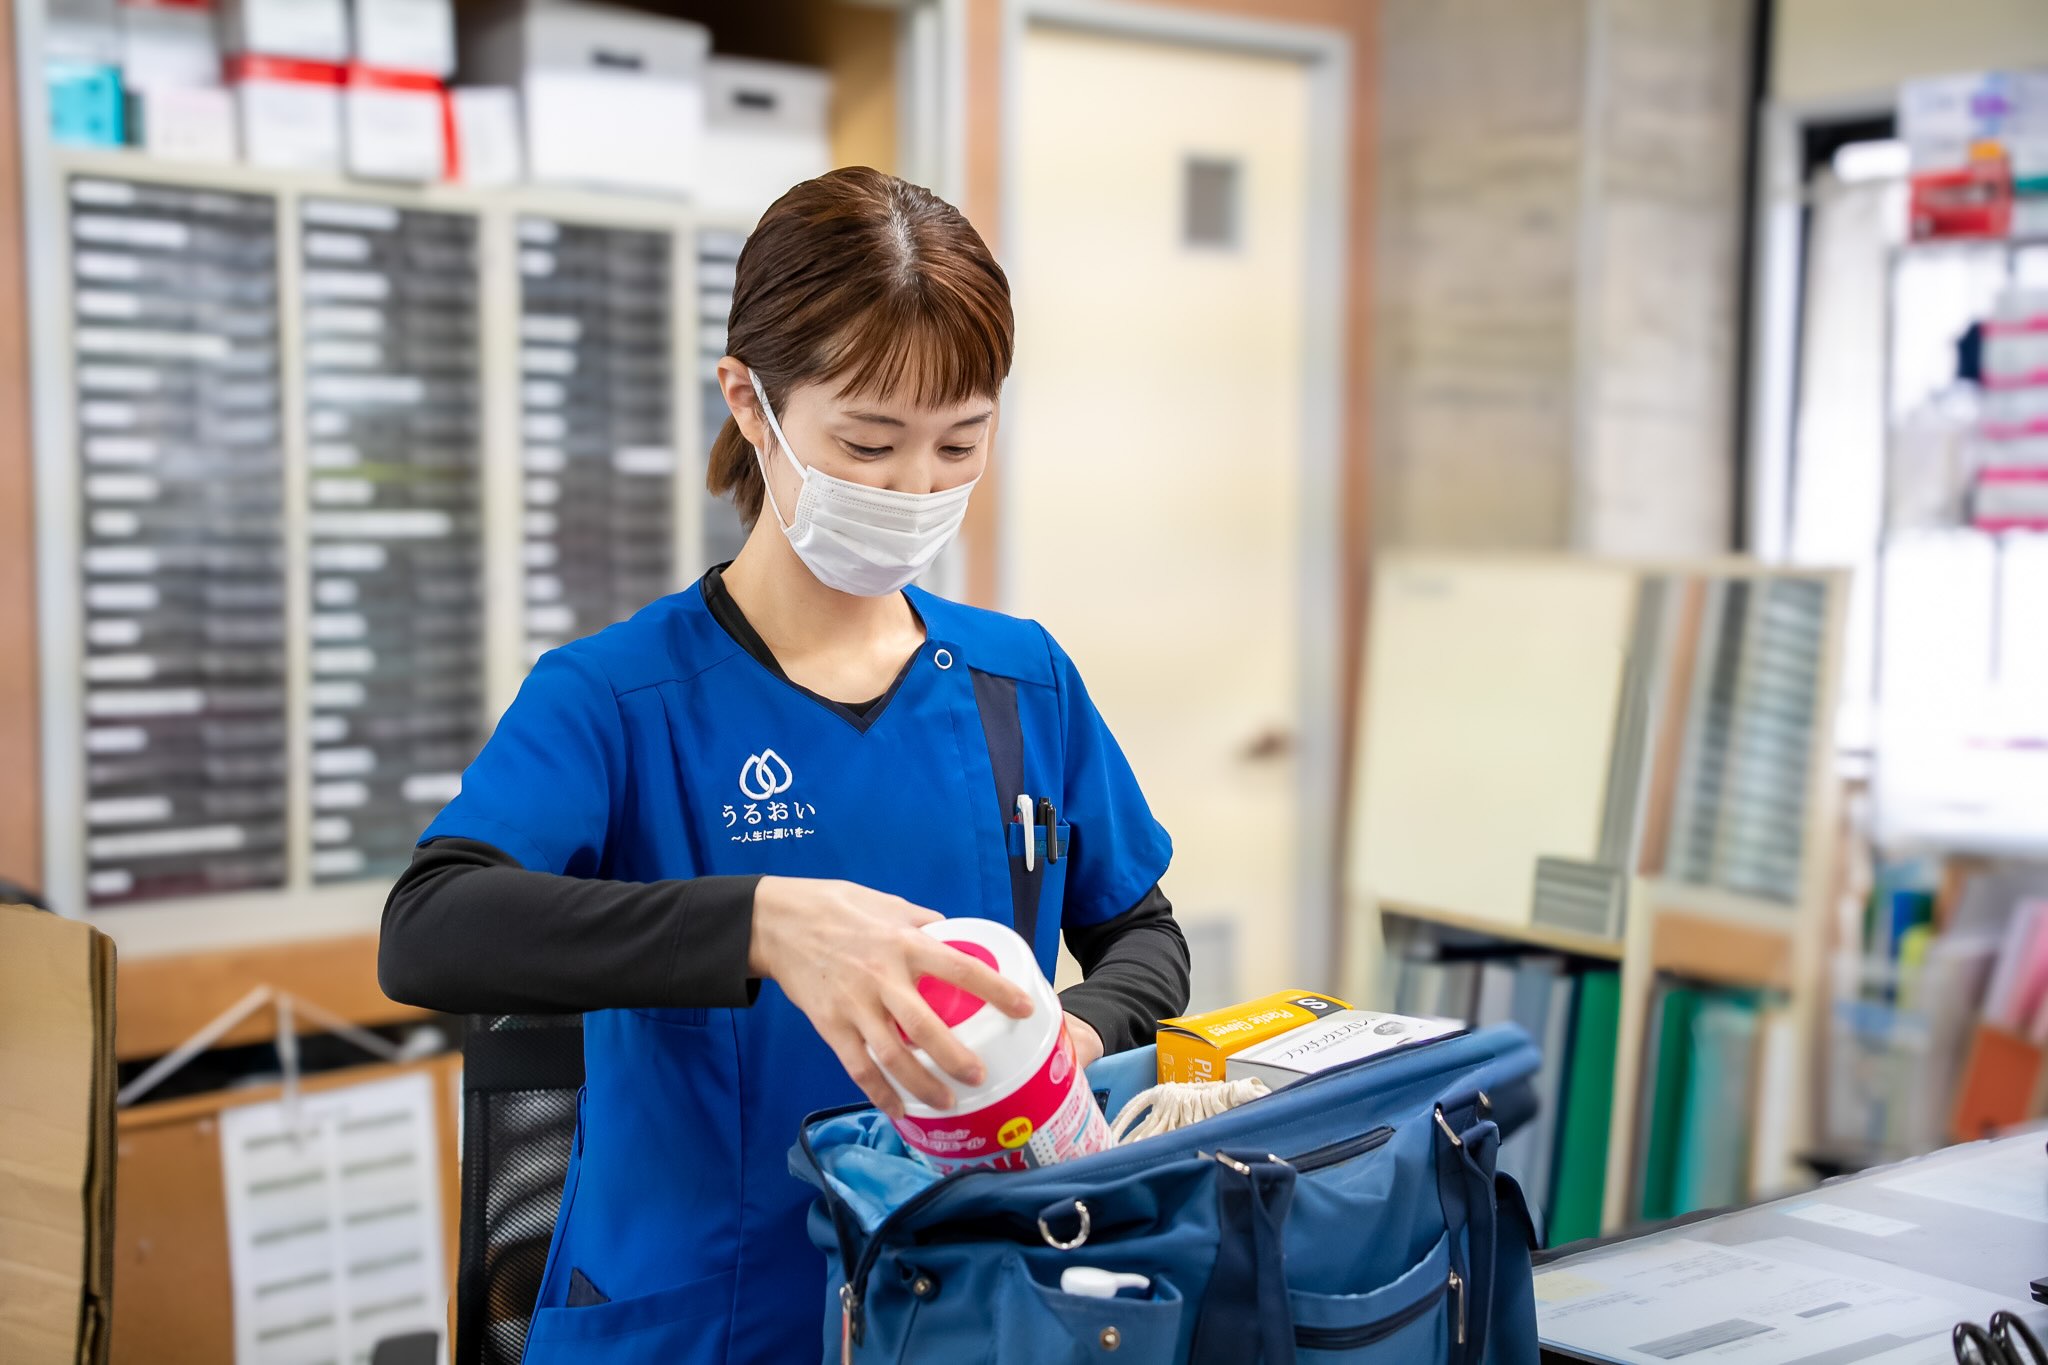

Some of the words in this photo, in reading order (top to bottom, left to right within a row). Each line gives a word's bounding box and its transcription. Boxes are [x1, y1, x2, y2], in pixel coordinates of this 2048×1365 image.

[722, 801, 816, 828] うるおい
[1297, 998, 1328, 1010] S
[1249, 1009, 1294, 1025] Plastic
[1209, 1021, 1253, 1037] Gloves
